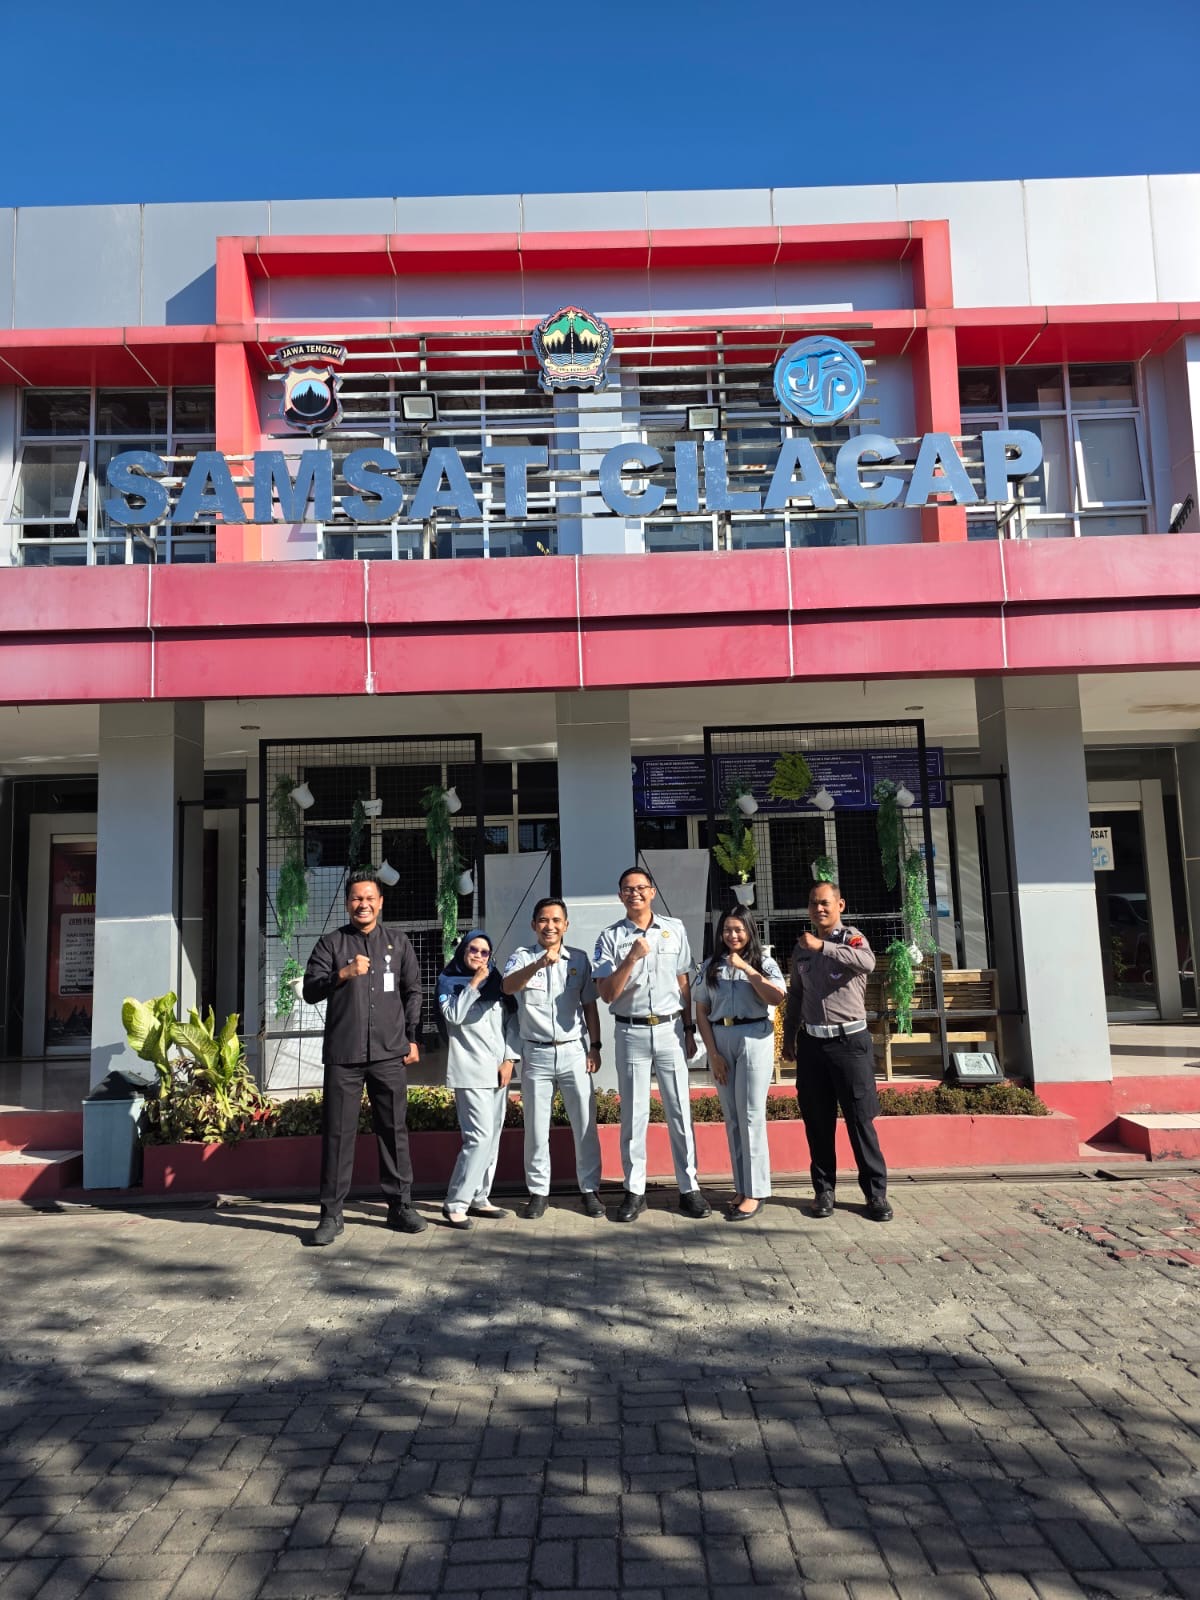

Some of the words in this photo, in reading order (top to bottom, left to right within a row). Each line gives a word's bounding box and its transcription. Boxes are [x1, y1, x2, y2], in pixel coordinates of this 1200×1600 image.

[282, 346, 304, 358] JAWA
[306, 344, 339, 356] TENGAH
[104, 445, 548, 525] SAMSAT
[598, 429, 1043, 516] CILACAP
